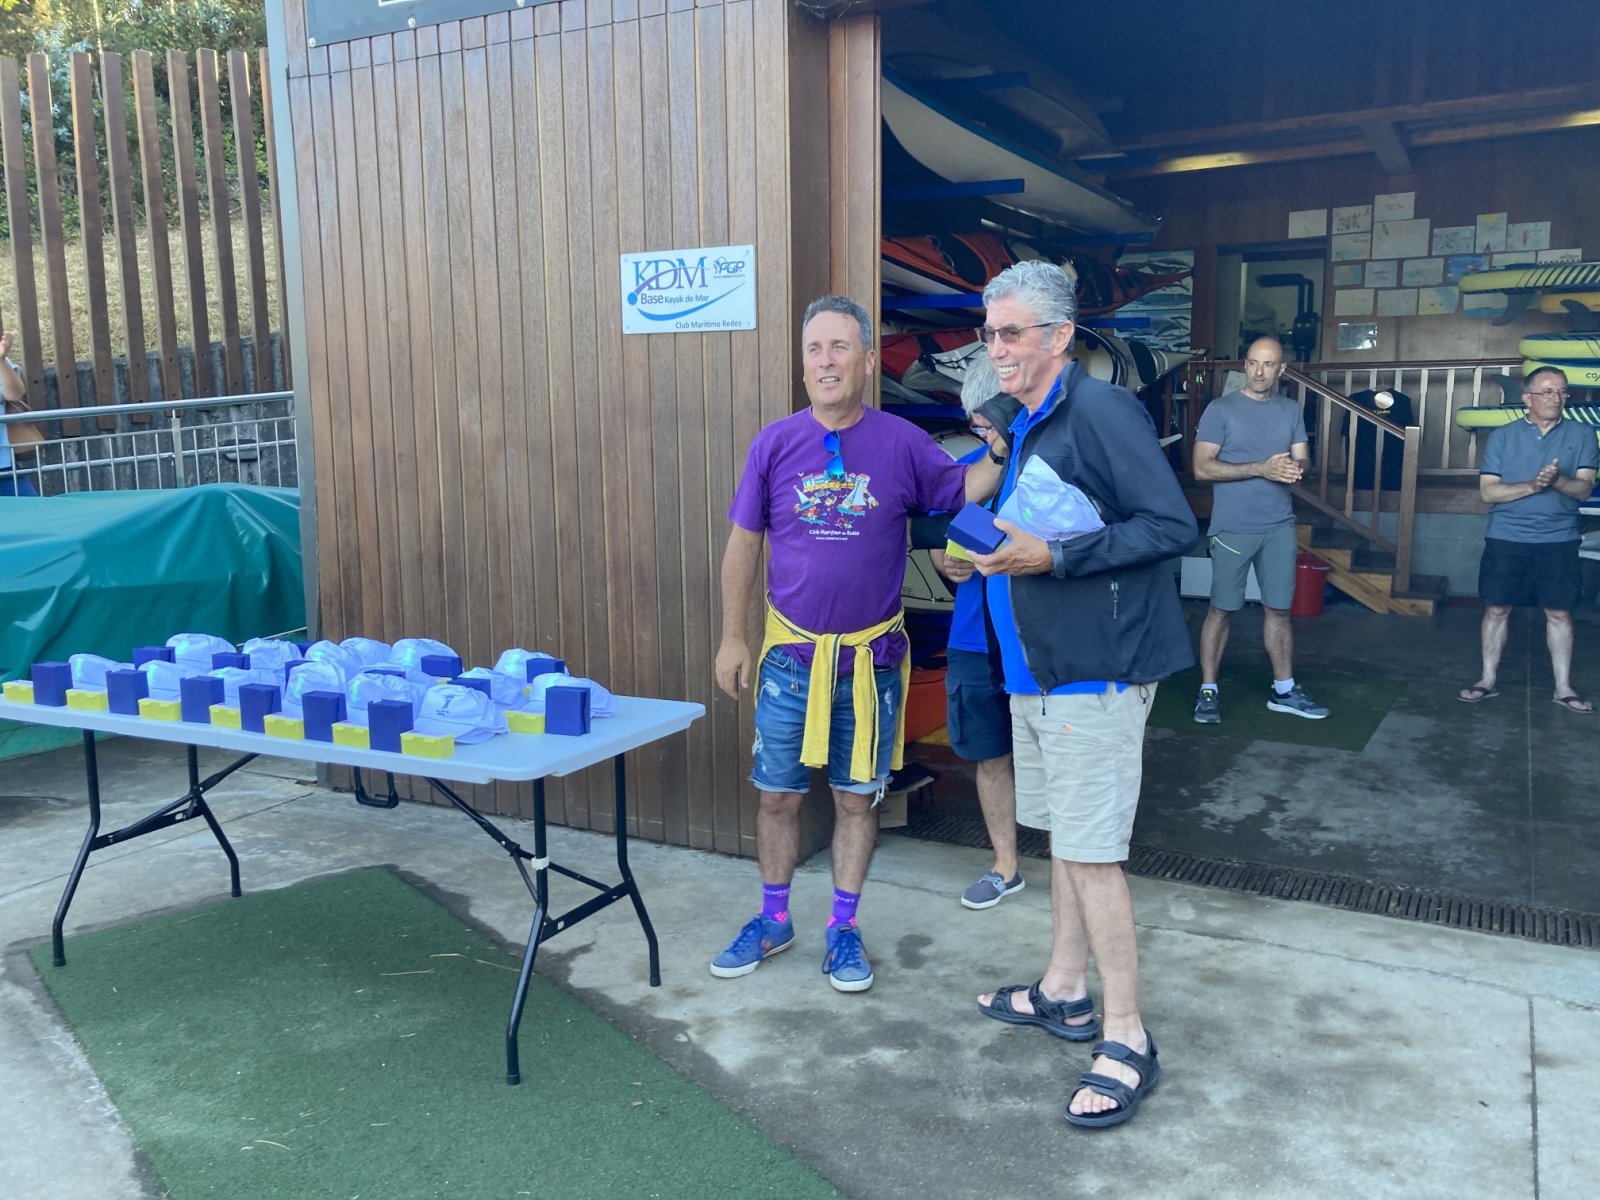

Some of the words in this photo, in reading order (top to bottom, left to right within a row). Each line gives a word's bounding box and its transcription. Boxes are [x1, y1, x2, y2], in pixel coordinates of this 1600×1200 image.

[632, 256, 708, 290] KDM
[641, 293, 664, 304] Base
[665, 296, 684, 305] Kayak
[685, 295, 693, 303] de
[695, 294, 709, 302] Mar
[675, 321, 690, 329] Club
[722, 319, 742, 327] Redes
